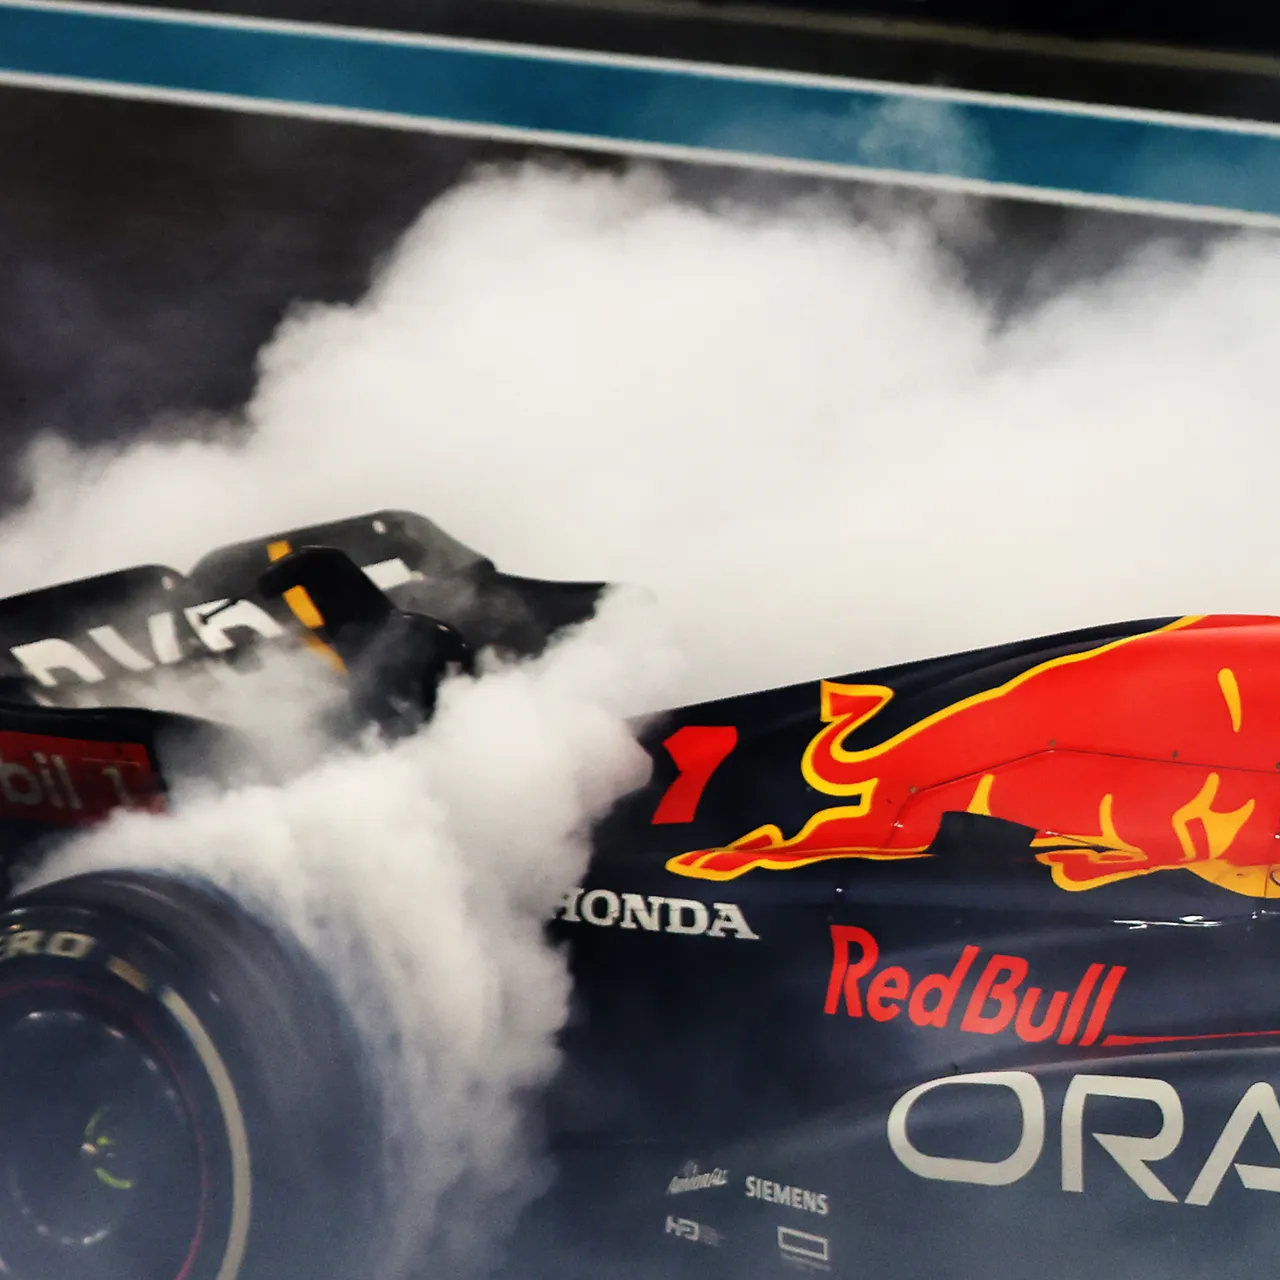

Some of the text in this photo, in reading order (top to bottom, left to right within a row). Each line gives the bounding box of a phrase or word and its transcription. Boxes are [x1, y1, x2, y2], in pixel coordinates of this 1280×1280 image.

[651, 726, 738, 824] 1
[824, 925, 1126, 1047] Red Bull
[745, 1175, 829, 1216] SIEMENS
